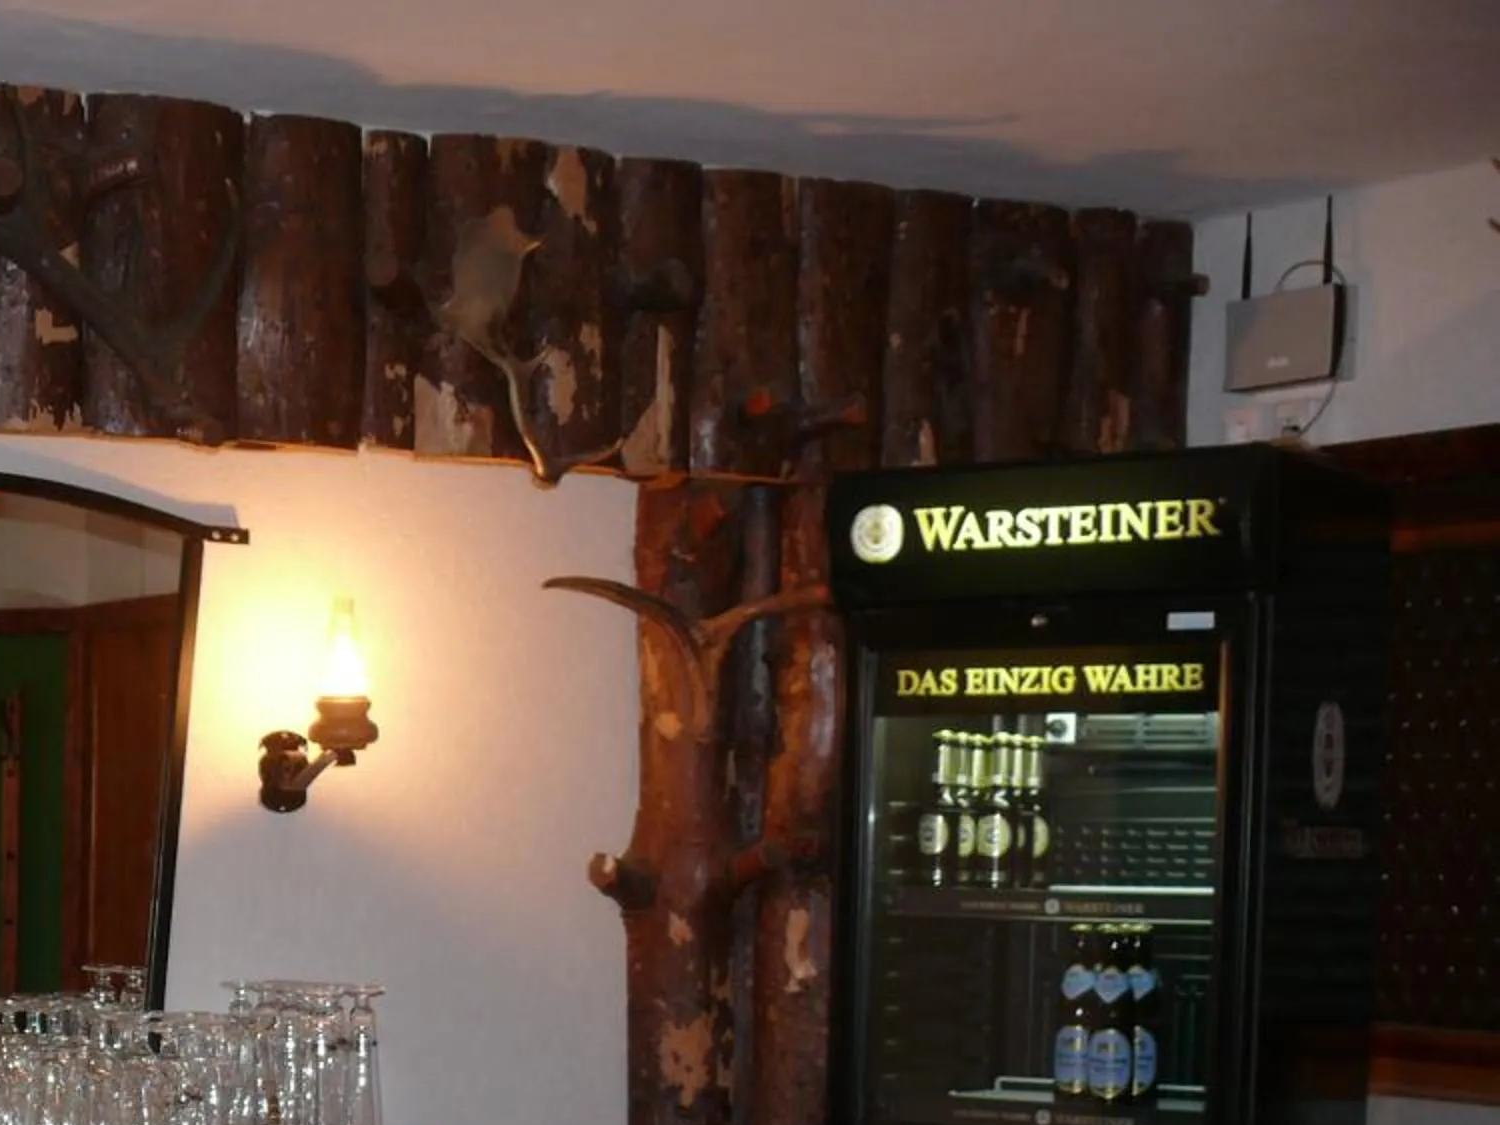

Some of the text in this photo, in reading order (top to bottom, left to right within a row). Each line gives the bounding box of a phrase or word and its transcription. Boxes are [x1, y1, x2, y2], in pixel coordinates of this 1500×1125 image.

[913, 498, 1221, 551] WARSTEINER
[896, 663, 1205, 696] DAS EINZIG WAHRE
